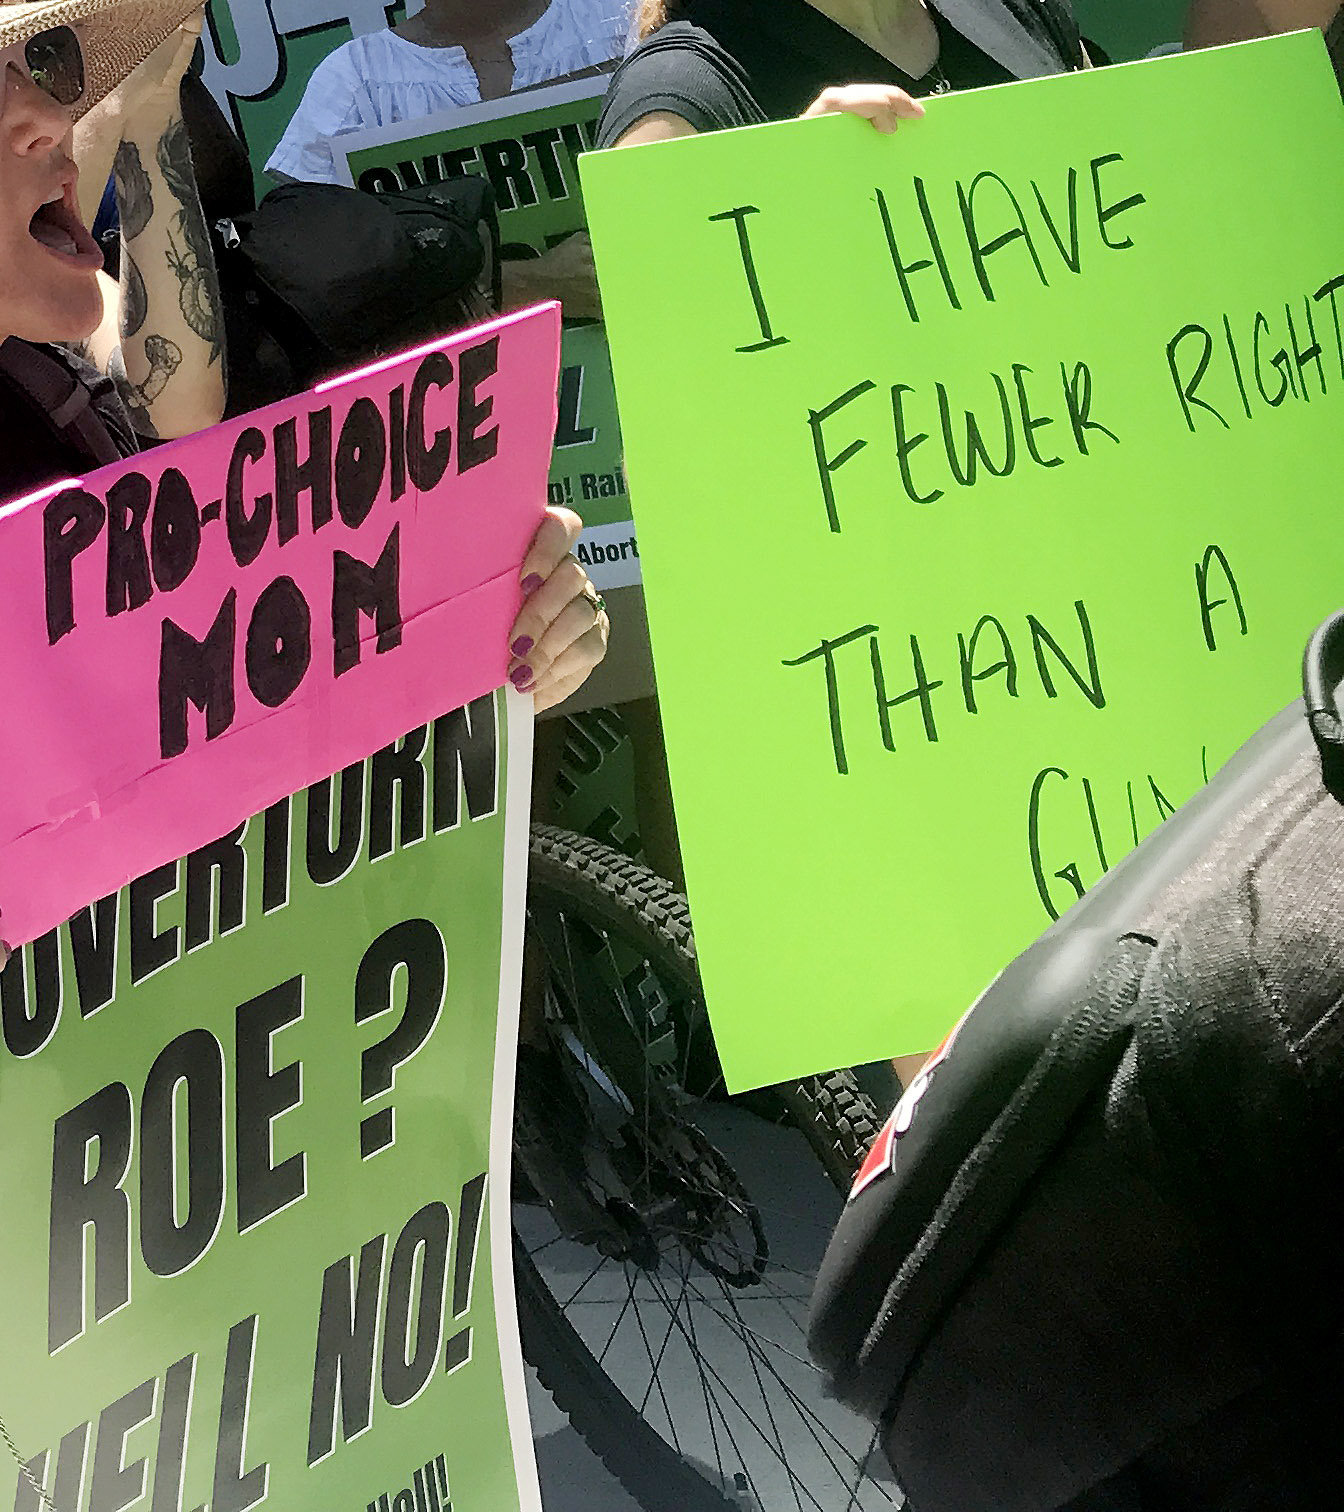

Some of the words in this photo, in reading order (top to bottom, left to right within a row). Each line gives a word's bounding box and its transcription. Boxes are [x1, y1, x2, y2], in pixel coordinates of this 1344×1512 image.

[708, 204, 791, 353] I
[873, 152, 1146, 323] HAVE
[42, 334, 501, 647] PRO-CHOICE
[808, 361, 1119, 533] FEWER
[158, 522, 403, 760] MOM
[781, 599, 1107, 775] THAN
[1194, 544, 1249, 652] A
[47, 973, 308, 1358] ROE
[307, 1171, 489, 1468] NO!
